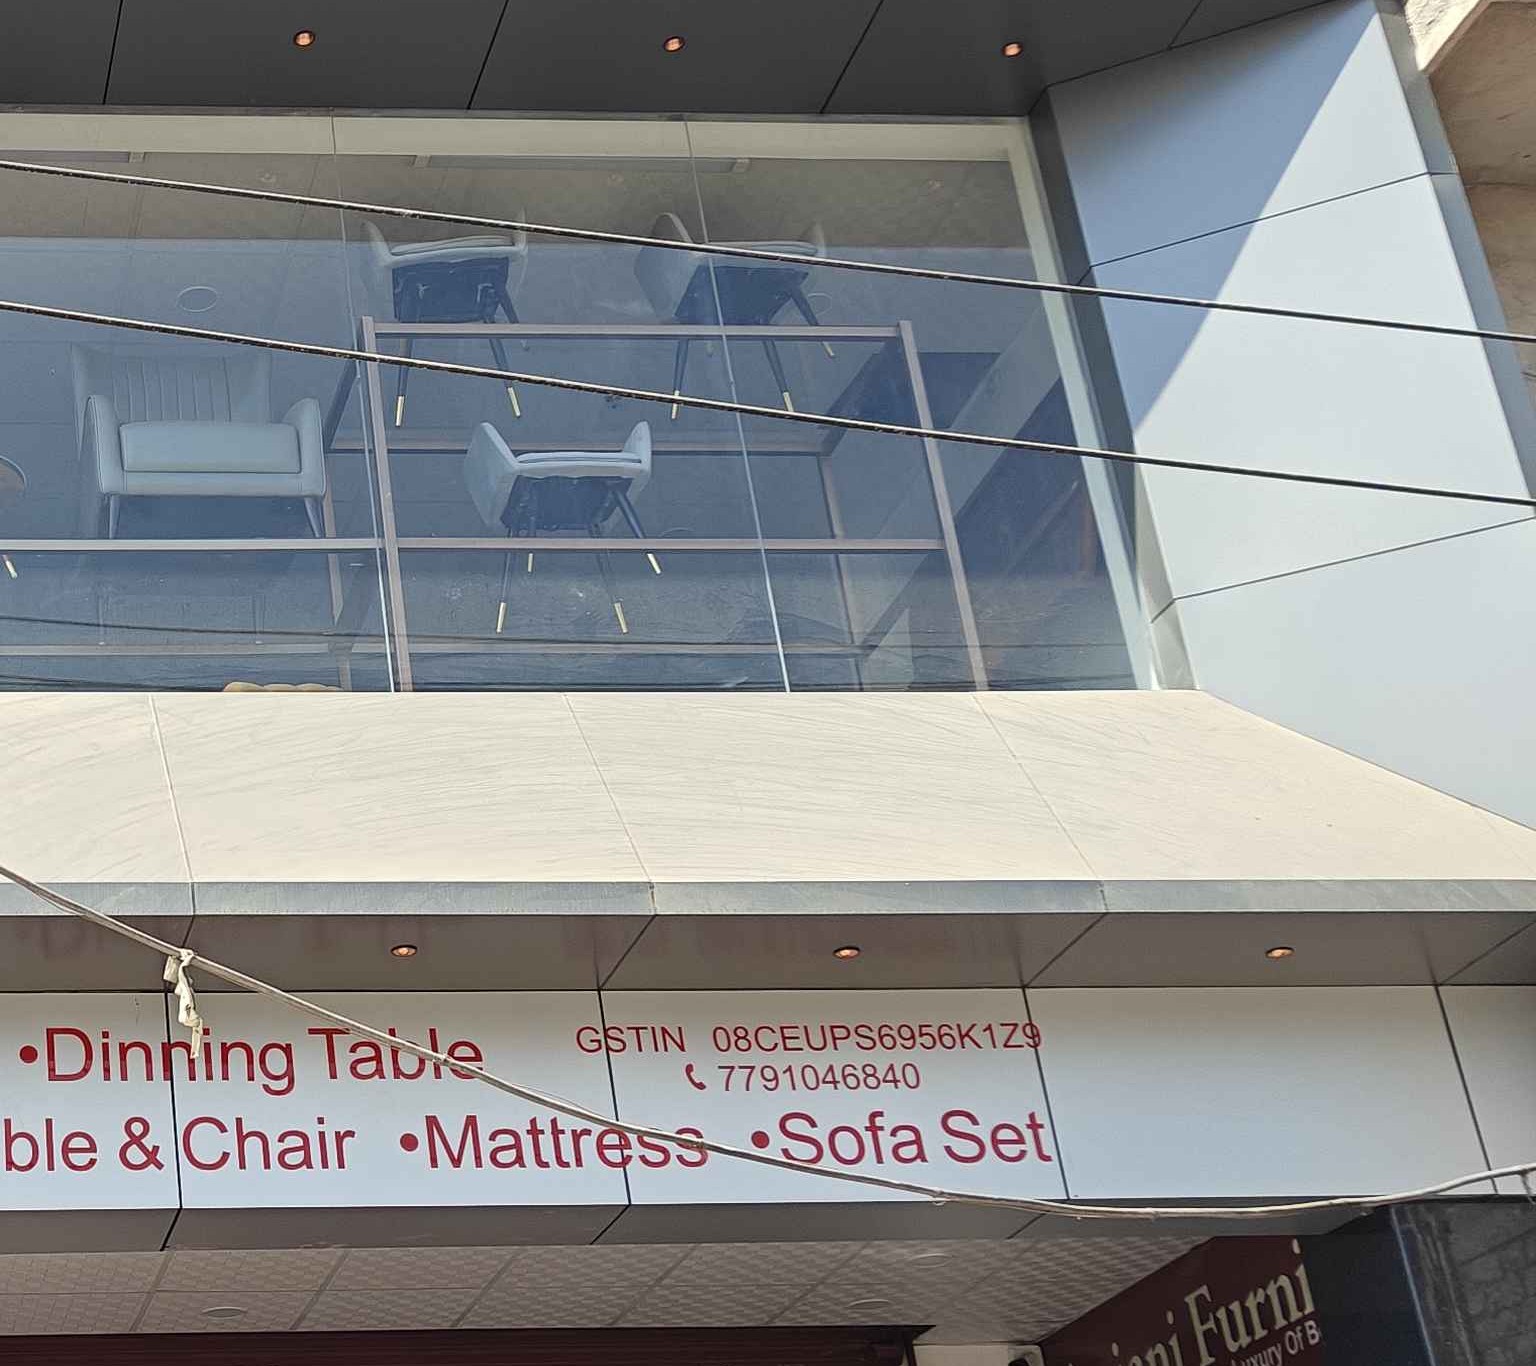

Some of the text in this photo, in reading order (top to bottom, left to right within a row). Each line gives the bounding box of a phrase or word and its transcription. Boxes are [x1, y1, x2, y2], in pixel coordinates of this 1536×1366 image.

[46, 1026, 484, 1096] Dinning Table
[575, 1022, 1042, 1053] GSTIN 08CEUPS6956K1Z9
[718, 1063, 921, 1091] 7791046840
[119, 1116, 164, 1171] &
[182, 1115, 356, 1170] Chair
[425, 1115, 709, 1170] Mattress
[779, 1109, 1054, 1165] Sofa Set
[1284, 1325, 1305, 1355] Of
[1304, 1319, 1322, 1346] B
